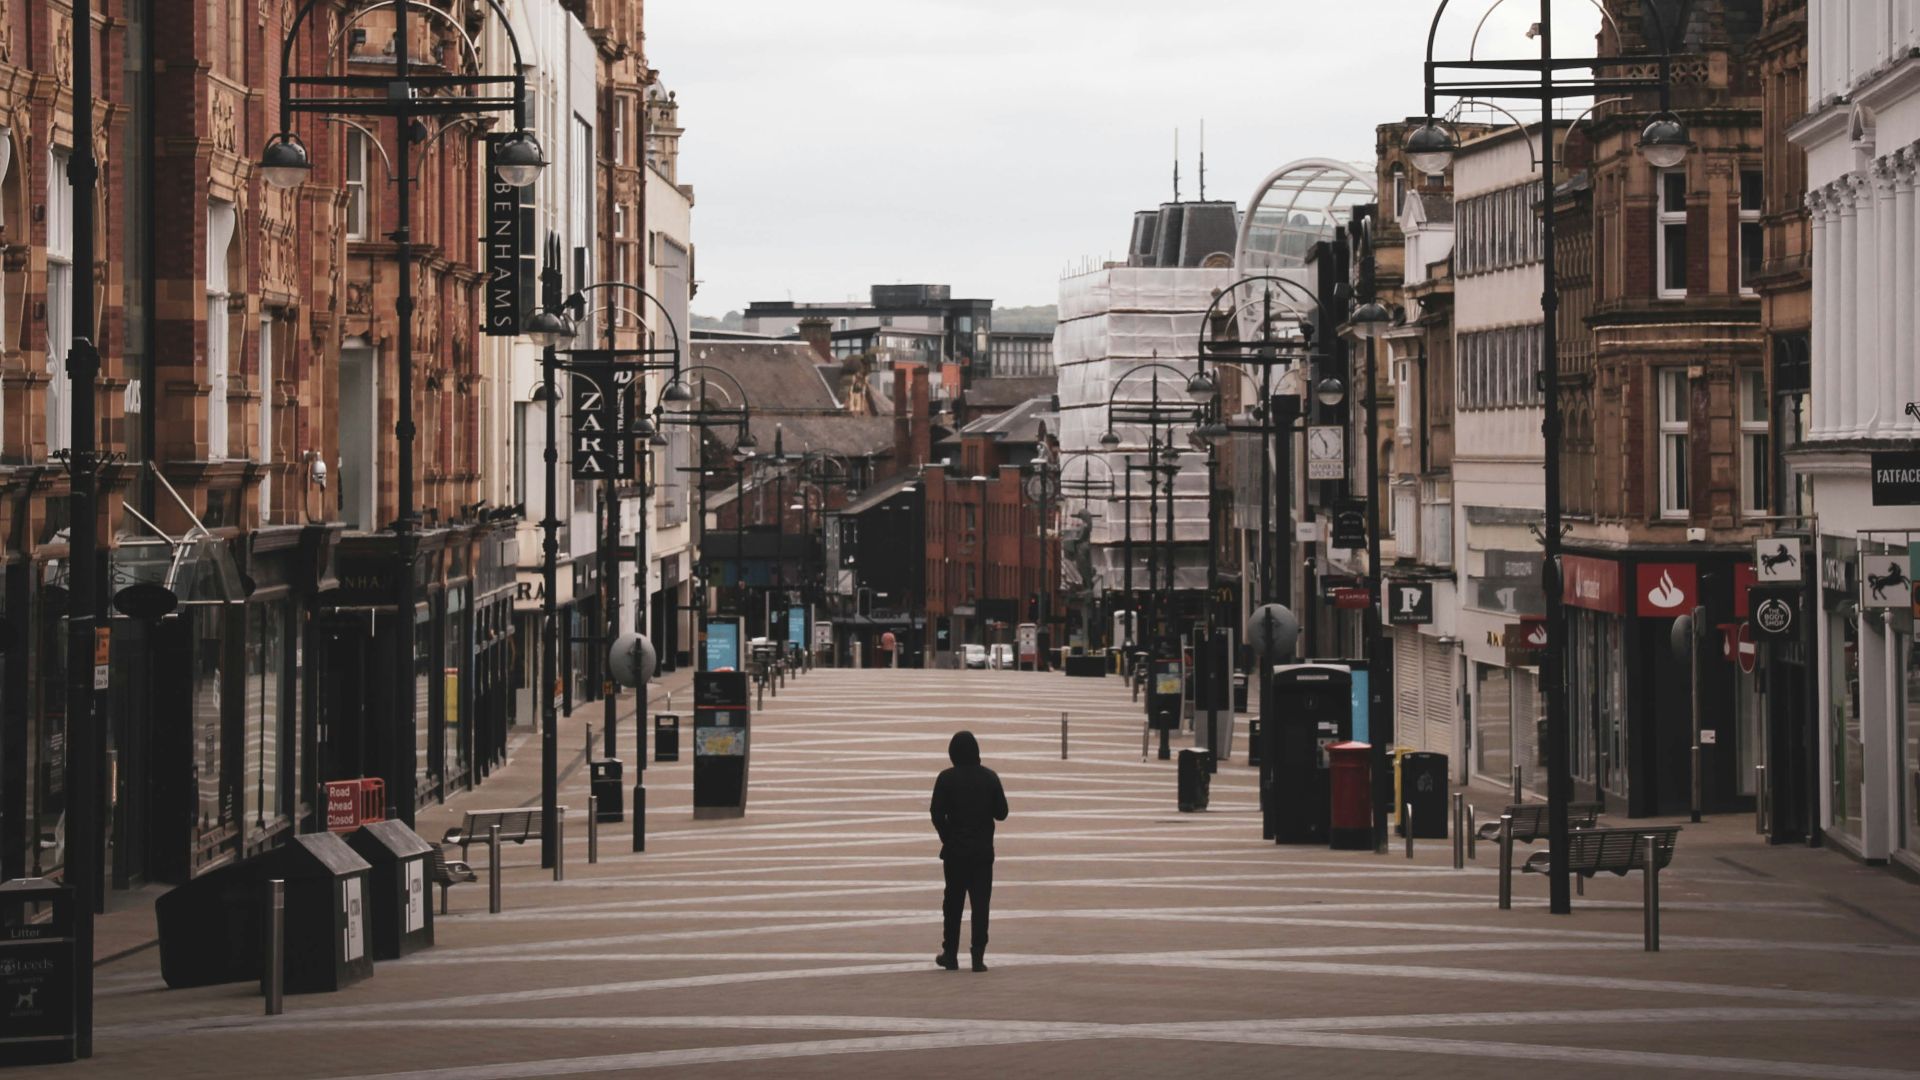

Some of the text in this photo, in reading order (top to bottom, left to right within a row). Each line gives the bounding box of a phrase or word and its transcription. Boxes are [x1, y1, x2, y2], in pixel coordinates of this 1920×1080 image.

[494, 142, 512, 328] BENHAMS
[578, 392, 605, 473] ZARA
[1877, 469, 1920, 483] FATFACE
[1765, 619, 1784, 627] SHOP
[329, 787, 351, 797] Road
[327, 801, 352, 812] Ahead
[327, 814, 354, 826] Closed
[10, 927, 40, 939] Litter
